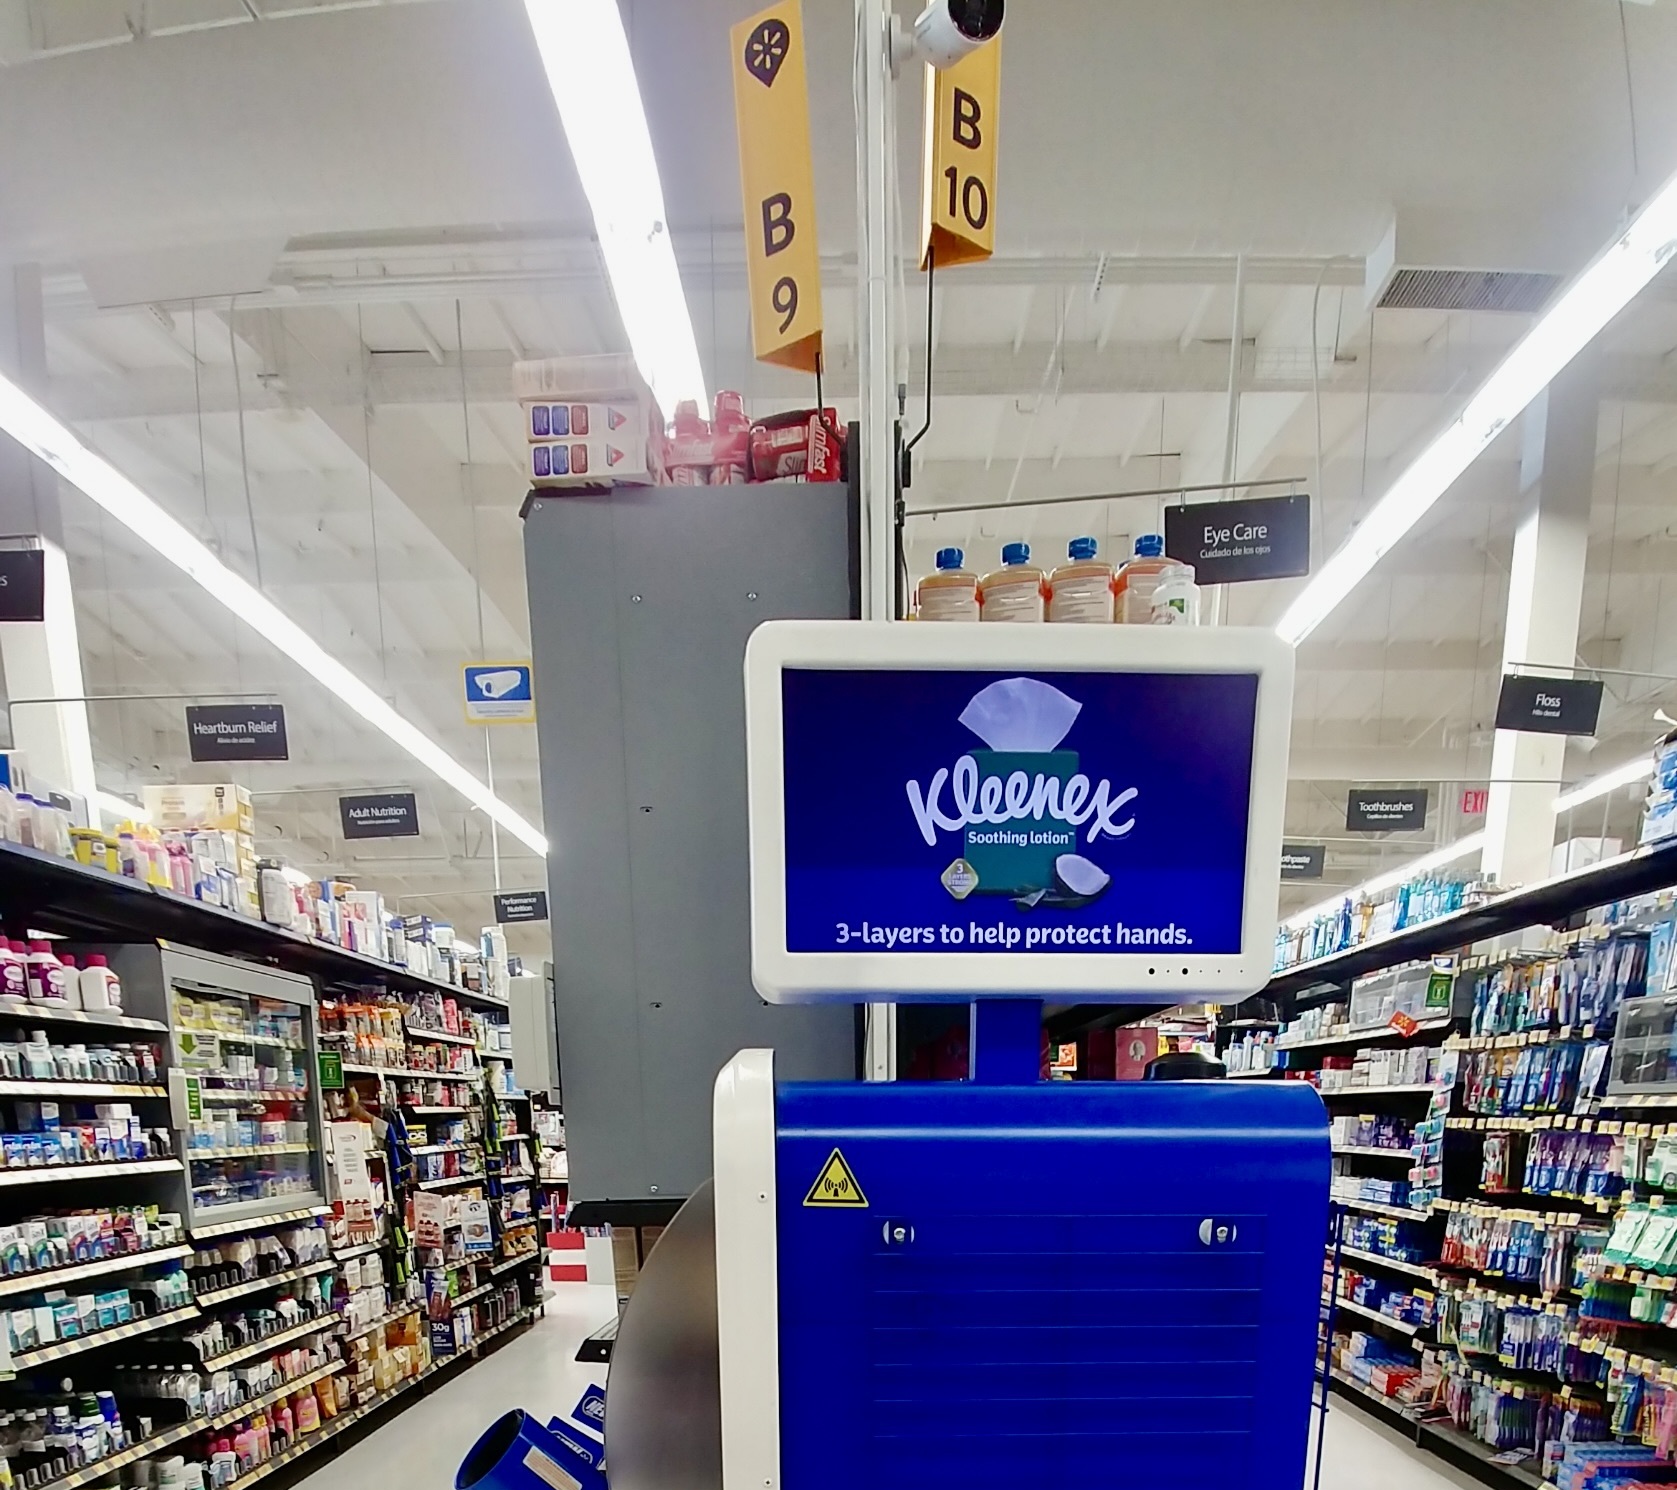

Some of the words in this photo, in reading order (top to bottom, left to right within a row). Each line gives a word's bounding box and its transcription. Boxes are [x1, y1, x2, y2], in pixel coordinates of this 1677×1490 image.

[954, 86, 982, 150] B
[944, 165, 988, 231] 10
[762, 192, 796, 257] B
[772, 276, 798, 335] 9
[1204, 526, 1230, 547] Eye
[1233, 523, 1268, 540] Care
[1200, 548, 1231, 558] Cuidado
[1243, 546, 1254, 554] los
[1535, 693, 1561, 708] Floss
[193, 721, 246, 735] Heartburn
[247, 721, 277, 733] Relief
[906, 755, 1138, 847] Kleenex
[1359, 802, 1413, 812] Toothbrushes
[349, 808, 370, 818] Adult
[370, 806, 407, 817] Nutrition
[968, 831, 1028, 847] Soothing
[1281, 855, 1310, 864] othpaste
[956, 863, 964, 874] 3
[835, 921, 935, 949] 3-layers
[939, 924, 964, 944] to
[969, 921, 1021, 949] help
[1025, 924, 1112, 949] protect
[1116, 922, 1193, 945] hands.
[431, 1323, 450, 1332] 30g
